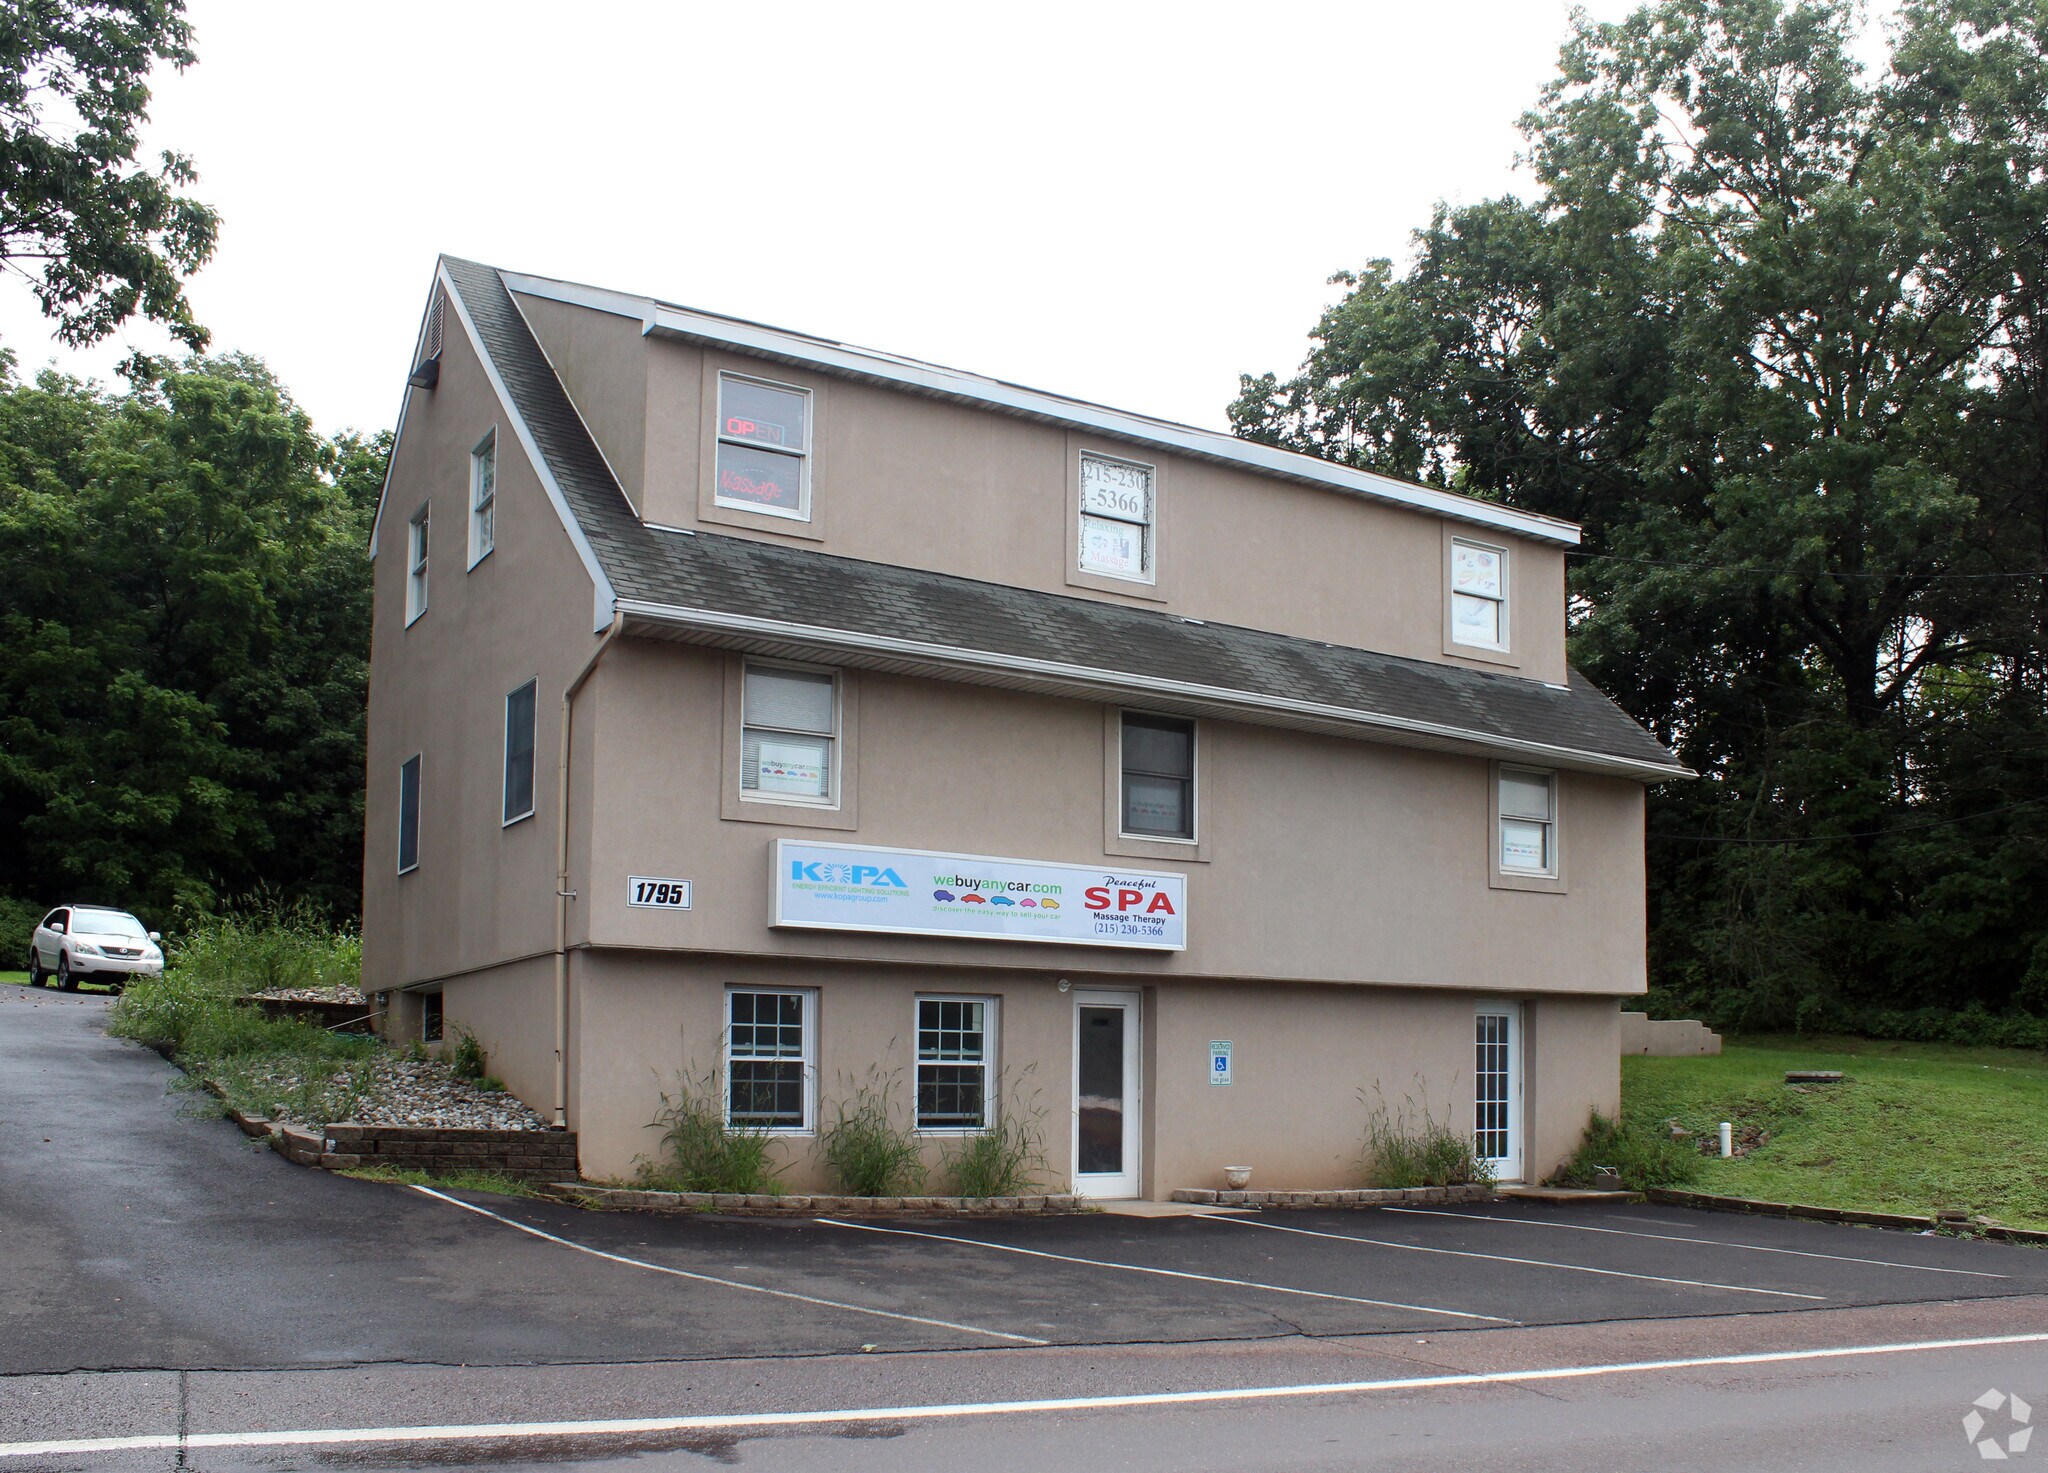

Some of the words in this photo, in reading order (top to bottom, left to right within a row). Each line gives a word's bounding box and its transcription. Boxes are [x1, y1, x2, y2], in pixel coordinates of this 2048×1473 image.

[727, 418, 780, 442] OPEN
[1085, 518, 1124, 537] Relaxing
[1091, 551, 1129, 570] Massage
[792, 861, 908, 888] KOPA
[1102, 875, 1157, 890] Peaceful
[636, 882, 684, 905] 1795
[792, 882, 816, 890] ENERGY
[818, 884, 847, 892] EFFICIENT
[847, 887, 875, 895] LIGHTING
[876, 889, 910, 897] SOLUTIONS
[933, 875, 1062, 894] webuyanycar.com
[814, 892, 888, 903] www.kopagroup.com
[1084, 887, 1176, 915] SPA
[932, 905, 962, 913] discover
[964, 906, 976, 914] the
[1093, 912, 1130, 923] Massage
[1132, 914, 1166, 926] Therapy
[1094, 922, 1119, 935] (215)
[1121, 924, 1163, 936] 230-5366
